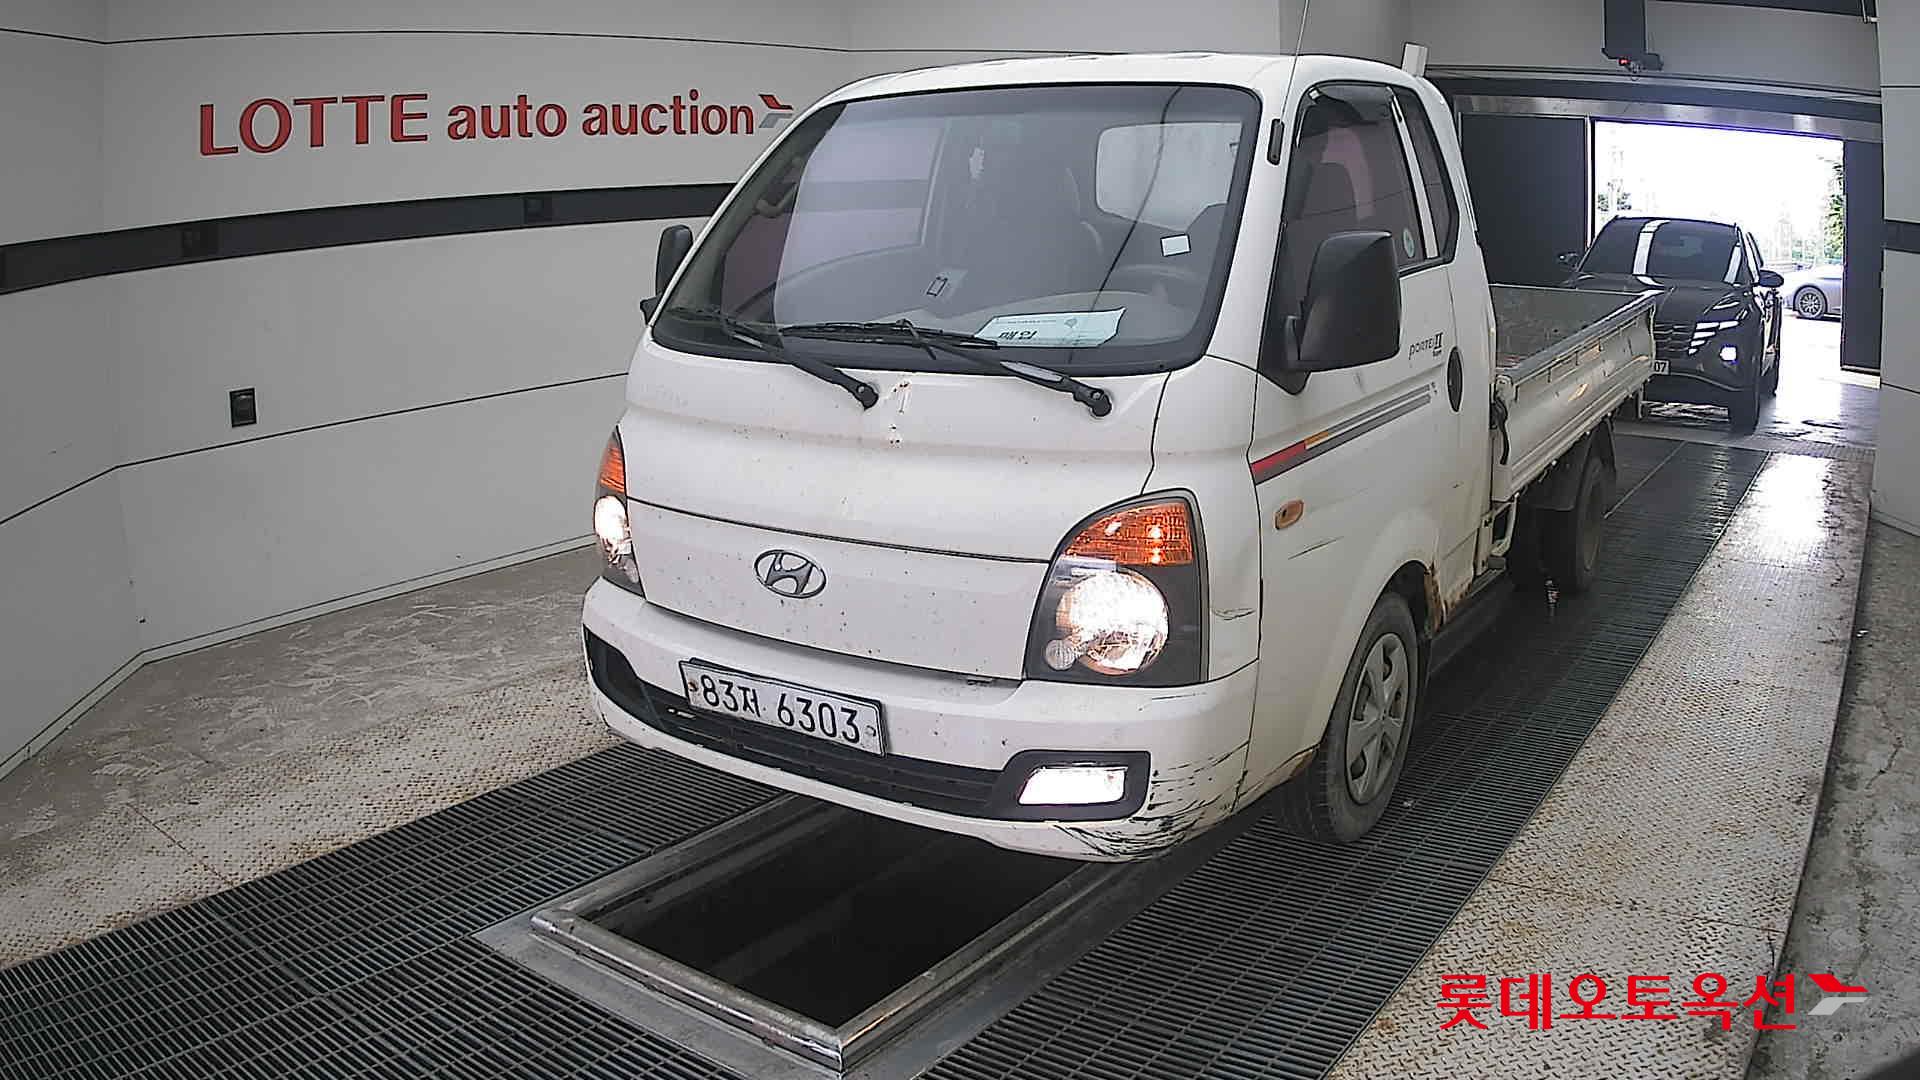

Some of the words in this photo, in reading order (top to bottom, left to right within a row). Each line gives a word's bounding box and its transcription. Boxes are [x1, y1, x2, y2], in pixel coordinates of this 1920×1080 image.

[199, 93, 429, 157] LOTTE
[446, 94, 568, 141] auto
[581, 88, 755, 137] auction
[700, 674, 761, 718] 83저
[777, 692, 861, 745] 6303
